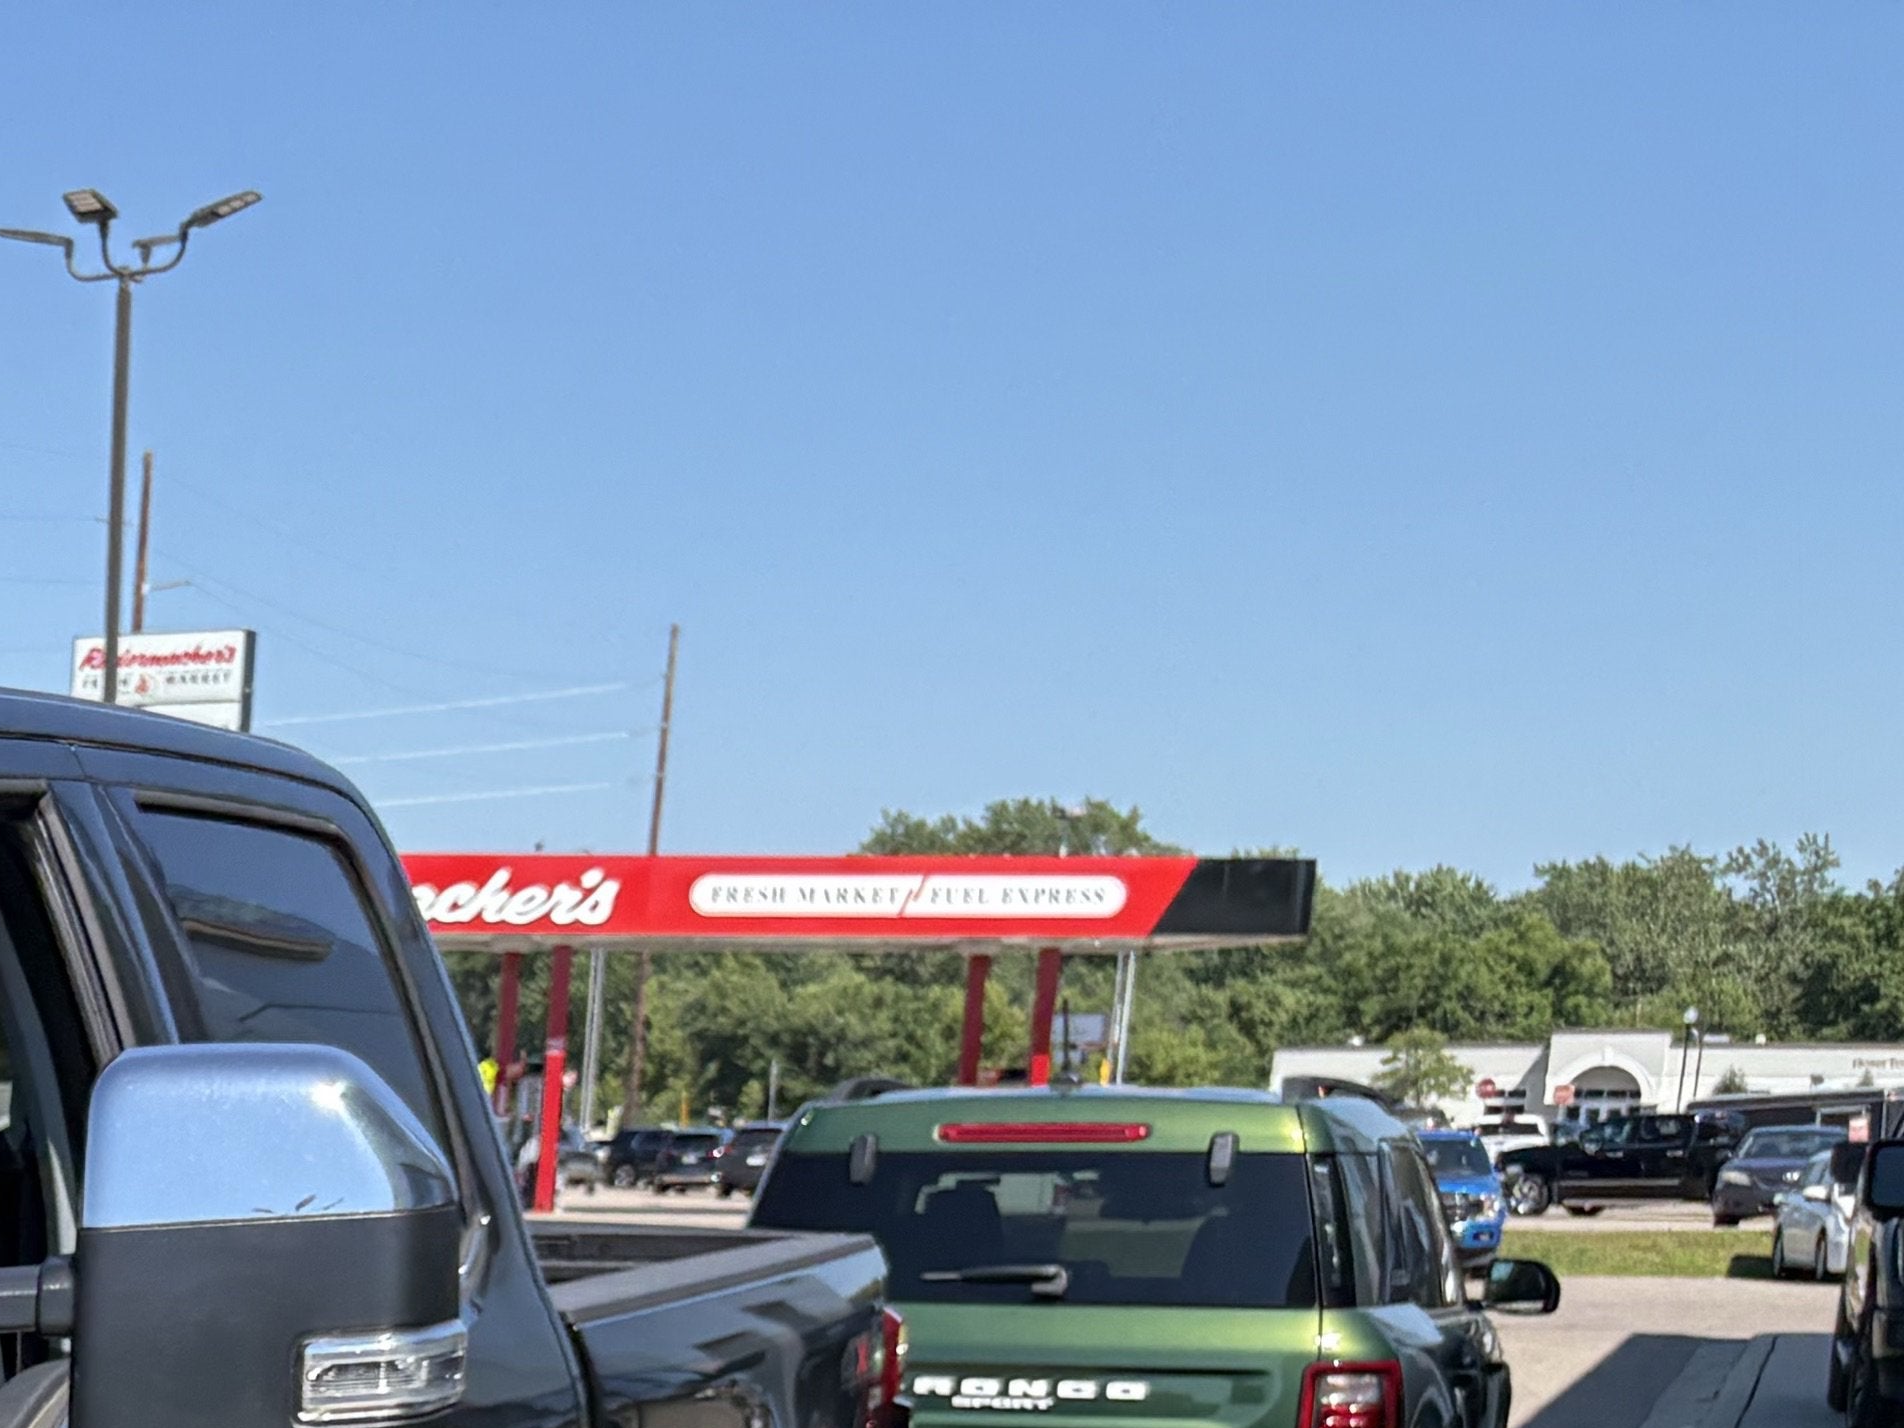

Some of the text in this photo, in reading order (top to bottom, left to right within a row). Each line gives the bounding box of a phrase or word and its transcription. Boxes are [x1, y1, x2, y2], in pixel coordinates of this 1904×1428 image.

[709, 886, 1107, 905] FRESH MARKET FUEL EXPRESS
[912, 1375, 1148, 1401] RONCO
[950, 1395, 1055, 1411] SPORT
